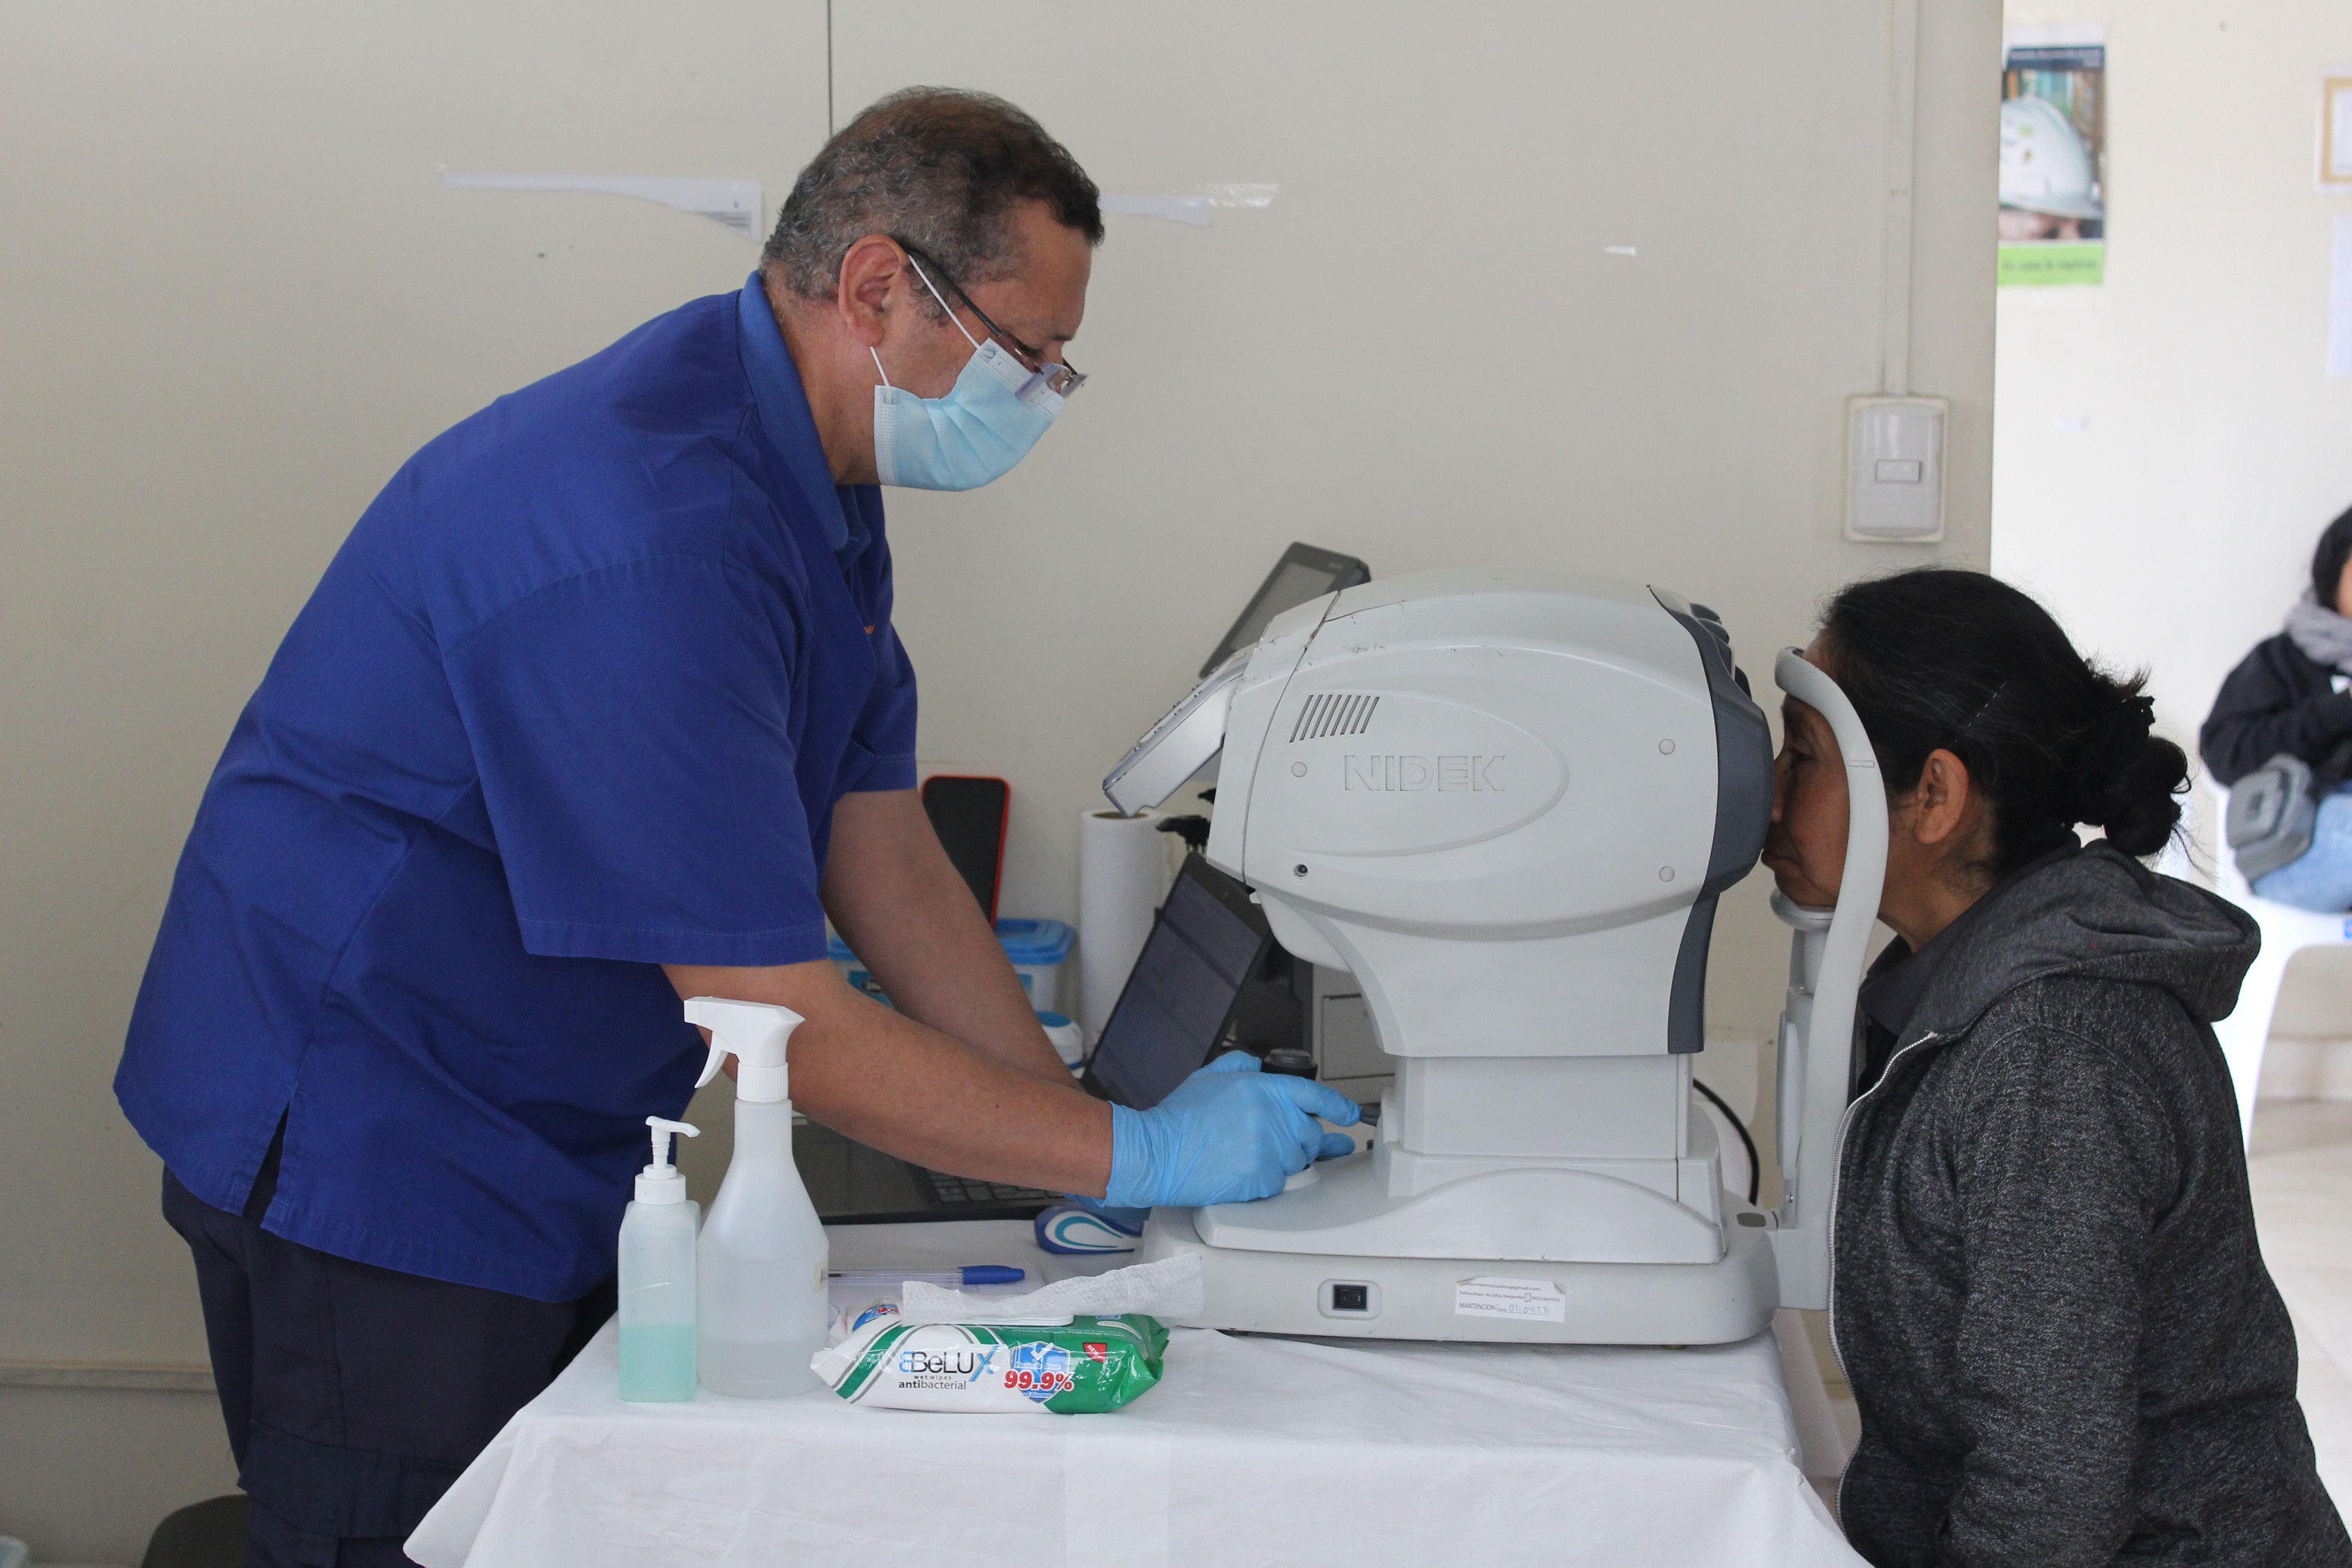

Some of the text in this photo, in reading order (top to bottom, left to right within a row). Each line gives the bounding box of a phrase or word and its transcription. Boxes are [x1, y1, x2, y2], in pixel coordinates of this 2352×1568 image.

[1344, 755, 1505, 792] NIDEK
[898, 1380, 966, 1390] antibacterial
[1004, 1370, 1074, 1390] 99.9%
